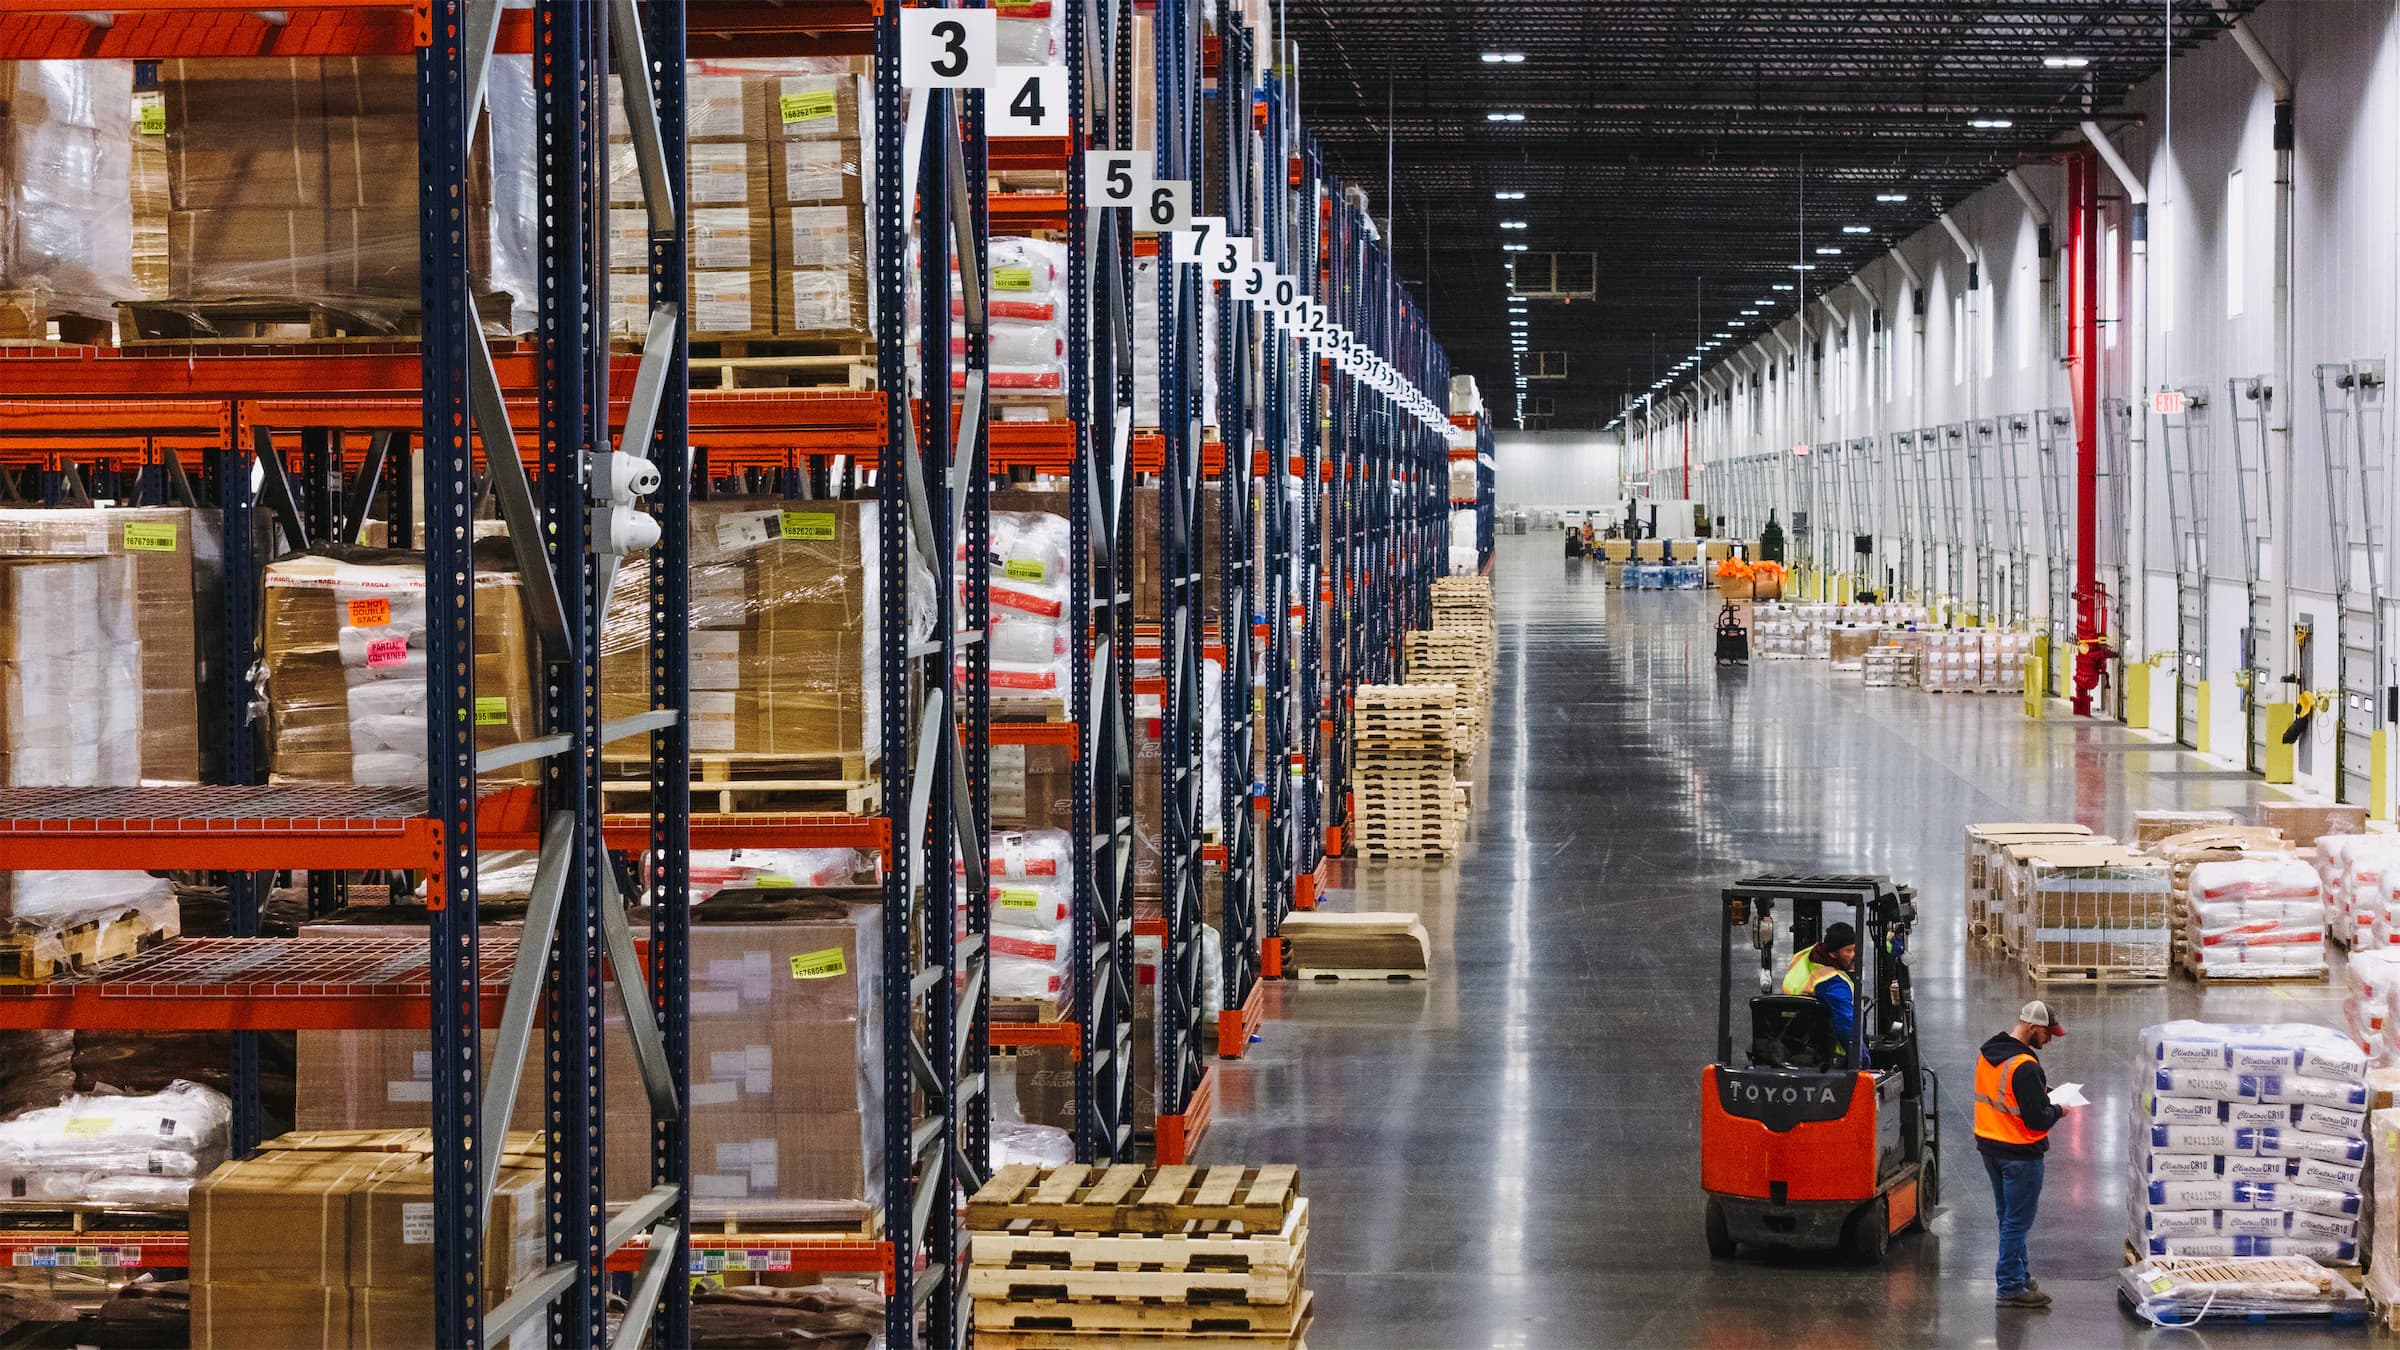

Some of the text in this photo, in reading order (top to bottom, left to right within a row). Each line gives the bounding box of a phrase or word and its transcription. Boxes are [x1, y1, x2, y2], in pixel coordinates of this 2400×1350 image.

[930, 20, 969, 78] 3
[1009, 76, 1046, 126] 4
[1105, 159, 1134, 200] 5
[1150, 187, 1175, 225] 6
[1191, 224, 1210, 256] 7
[2155, 394, 2180, 412] EXIT
[361, 581, 390, 589] FRAGILE
[352, 608, 385, 617] DOUBLE
[367, 600, 384, 608] NOT
[356, 616, 384, 624] STACK
[371, 640, 401, 651] PARTIAL
[367, 651, 407, 663] CONTAINER
[1730, 1080, 1836, 1103] TOYOTA
